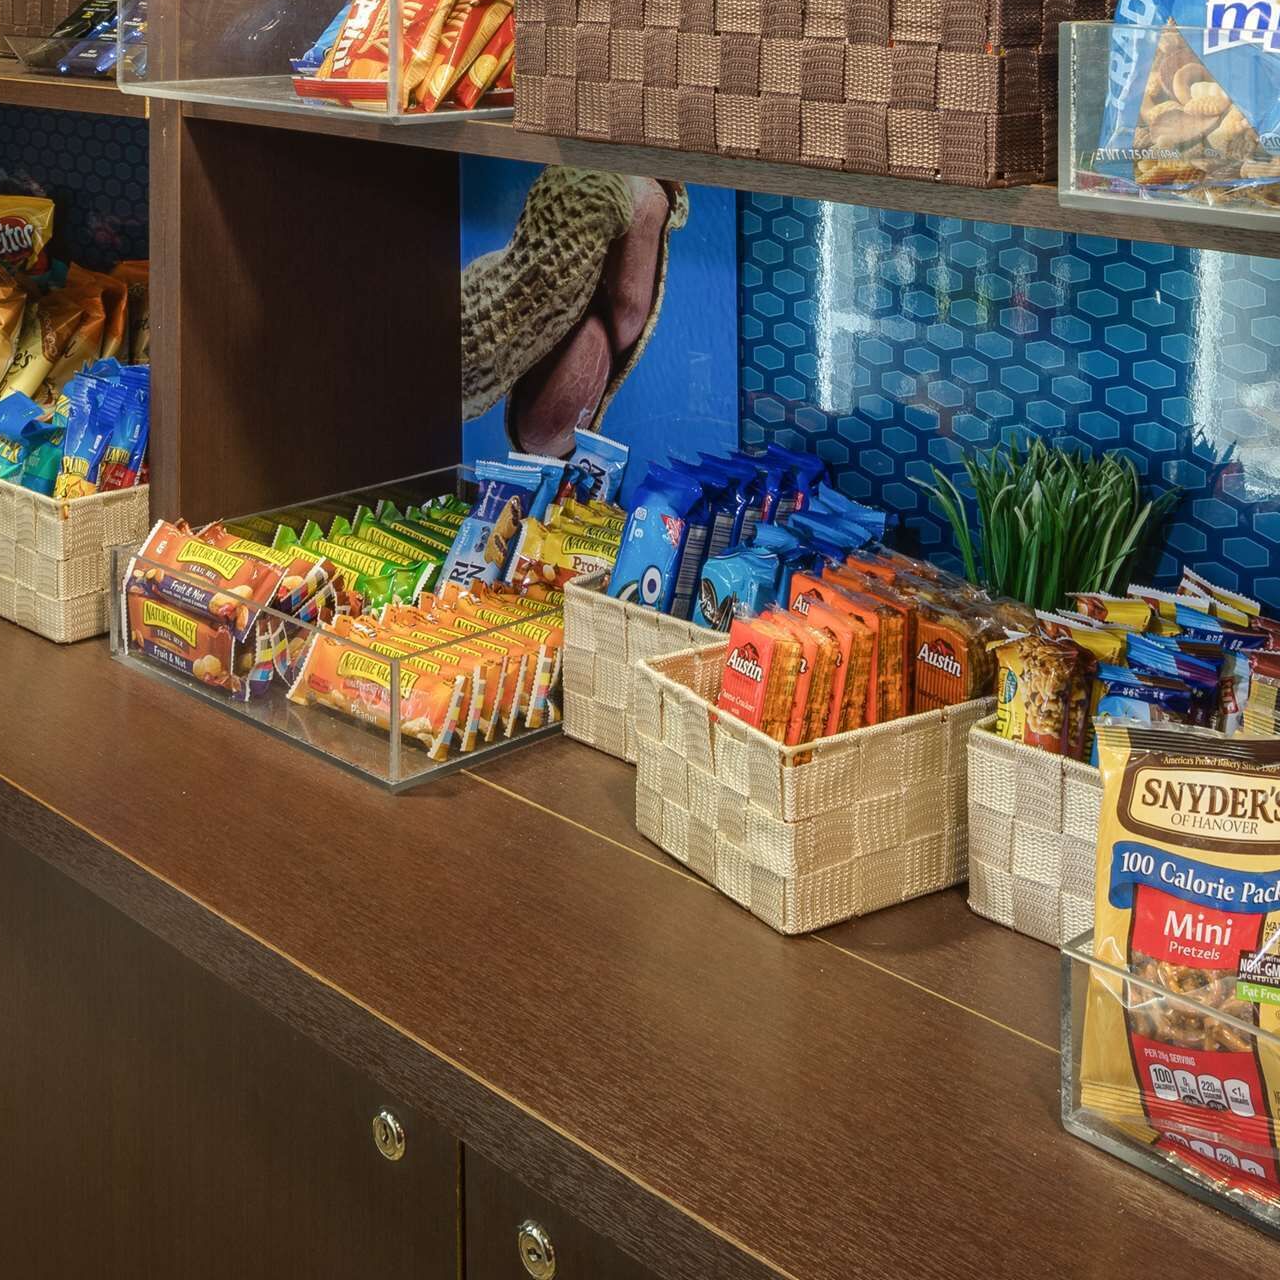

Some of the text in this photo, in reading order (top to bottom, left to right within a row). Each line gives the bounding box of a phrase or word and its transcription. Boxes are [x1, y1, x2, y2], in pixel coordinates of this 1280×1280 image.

[145, 602, 196, 645] NATURE VALLEY
[154, 646, 168, 660] Fruit
[175, 655, 187, 669] Nut
[727, 648, 763, 682] Austin
[918, 643, 961, 677] Austin
[350, 703, 377, 723] Peanut
[1120, 849, 1152, 877] 100
[1158, 861, 1235, 903] Calorie
[1169, 940, 1222, 961] Pretzels
[1242, 983, 1258, 996] Fat
